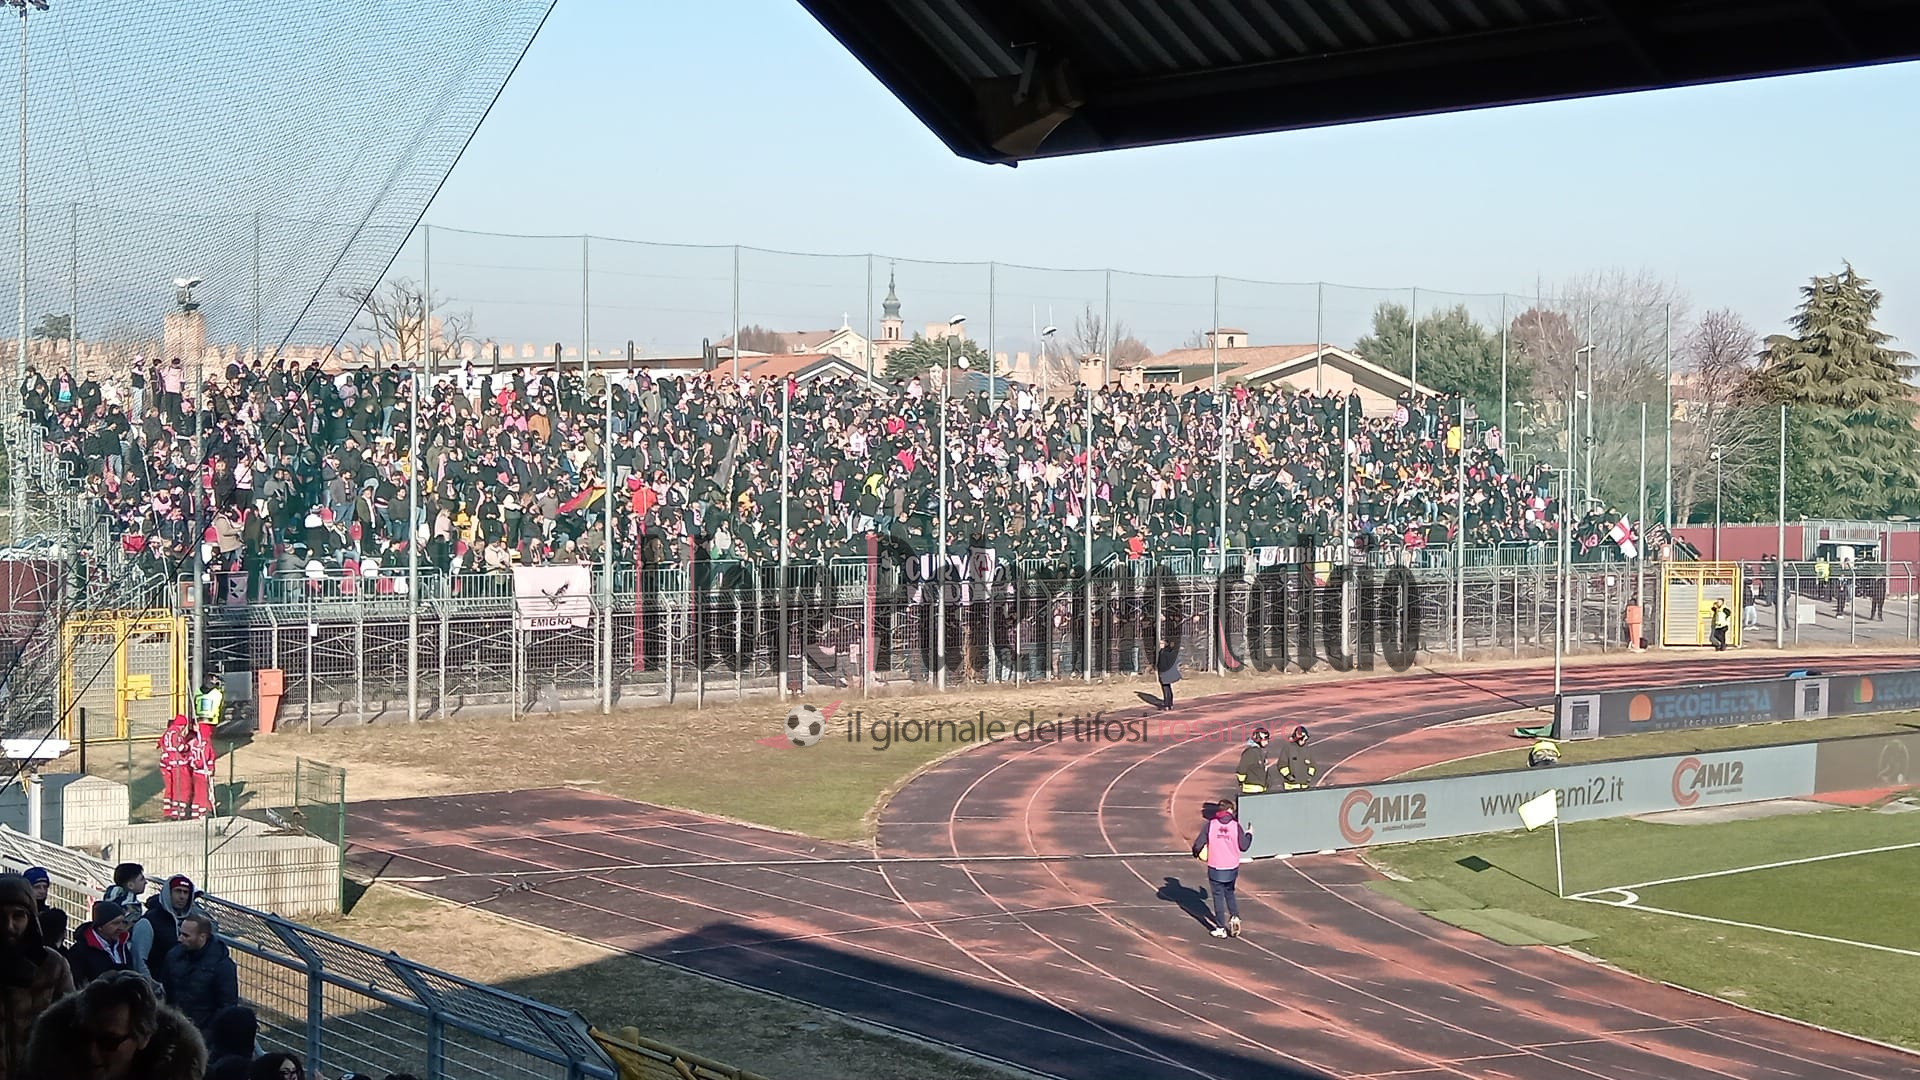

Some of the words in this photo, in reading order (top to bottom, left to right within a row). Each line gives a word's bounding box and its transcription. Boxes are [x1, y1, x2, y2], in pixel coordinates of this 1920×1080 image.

[1480, 776, 1624, 817] wwwami2.it
[1672, 757, 1744, 807] CAMI2
[1338, 788, 1427, 845] CAMI2
